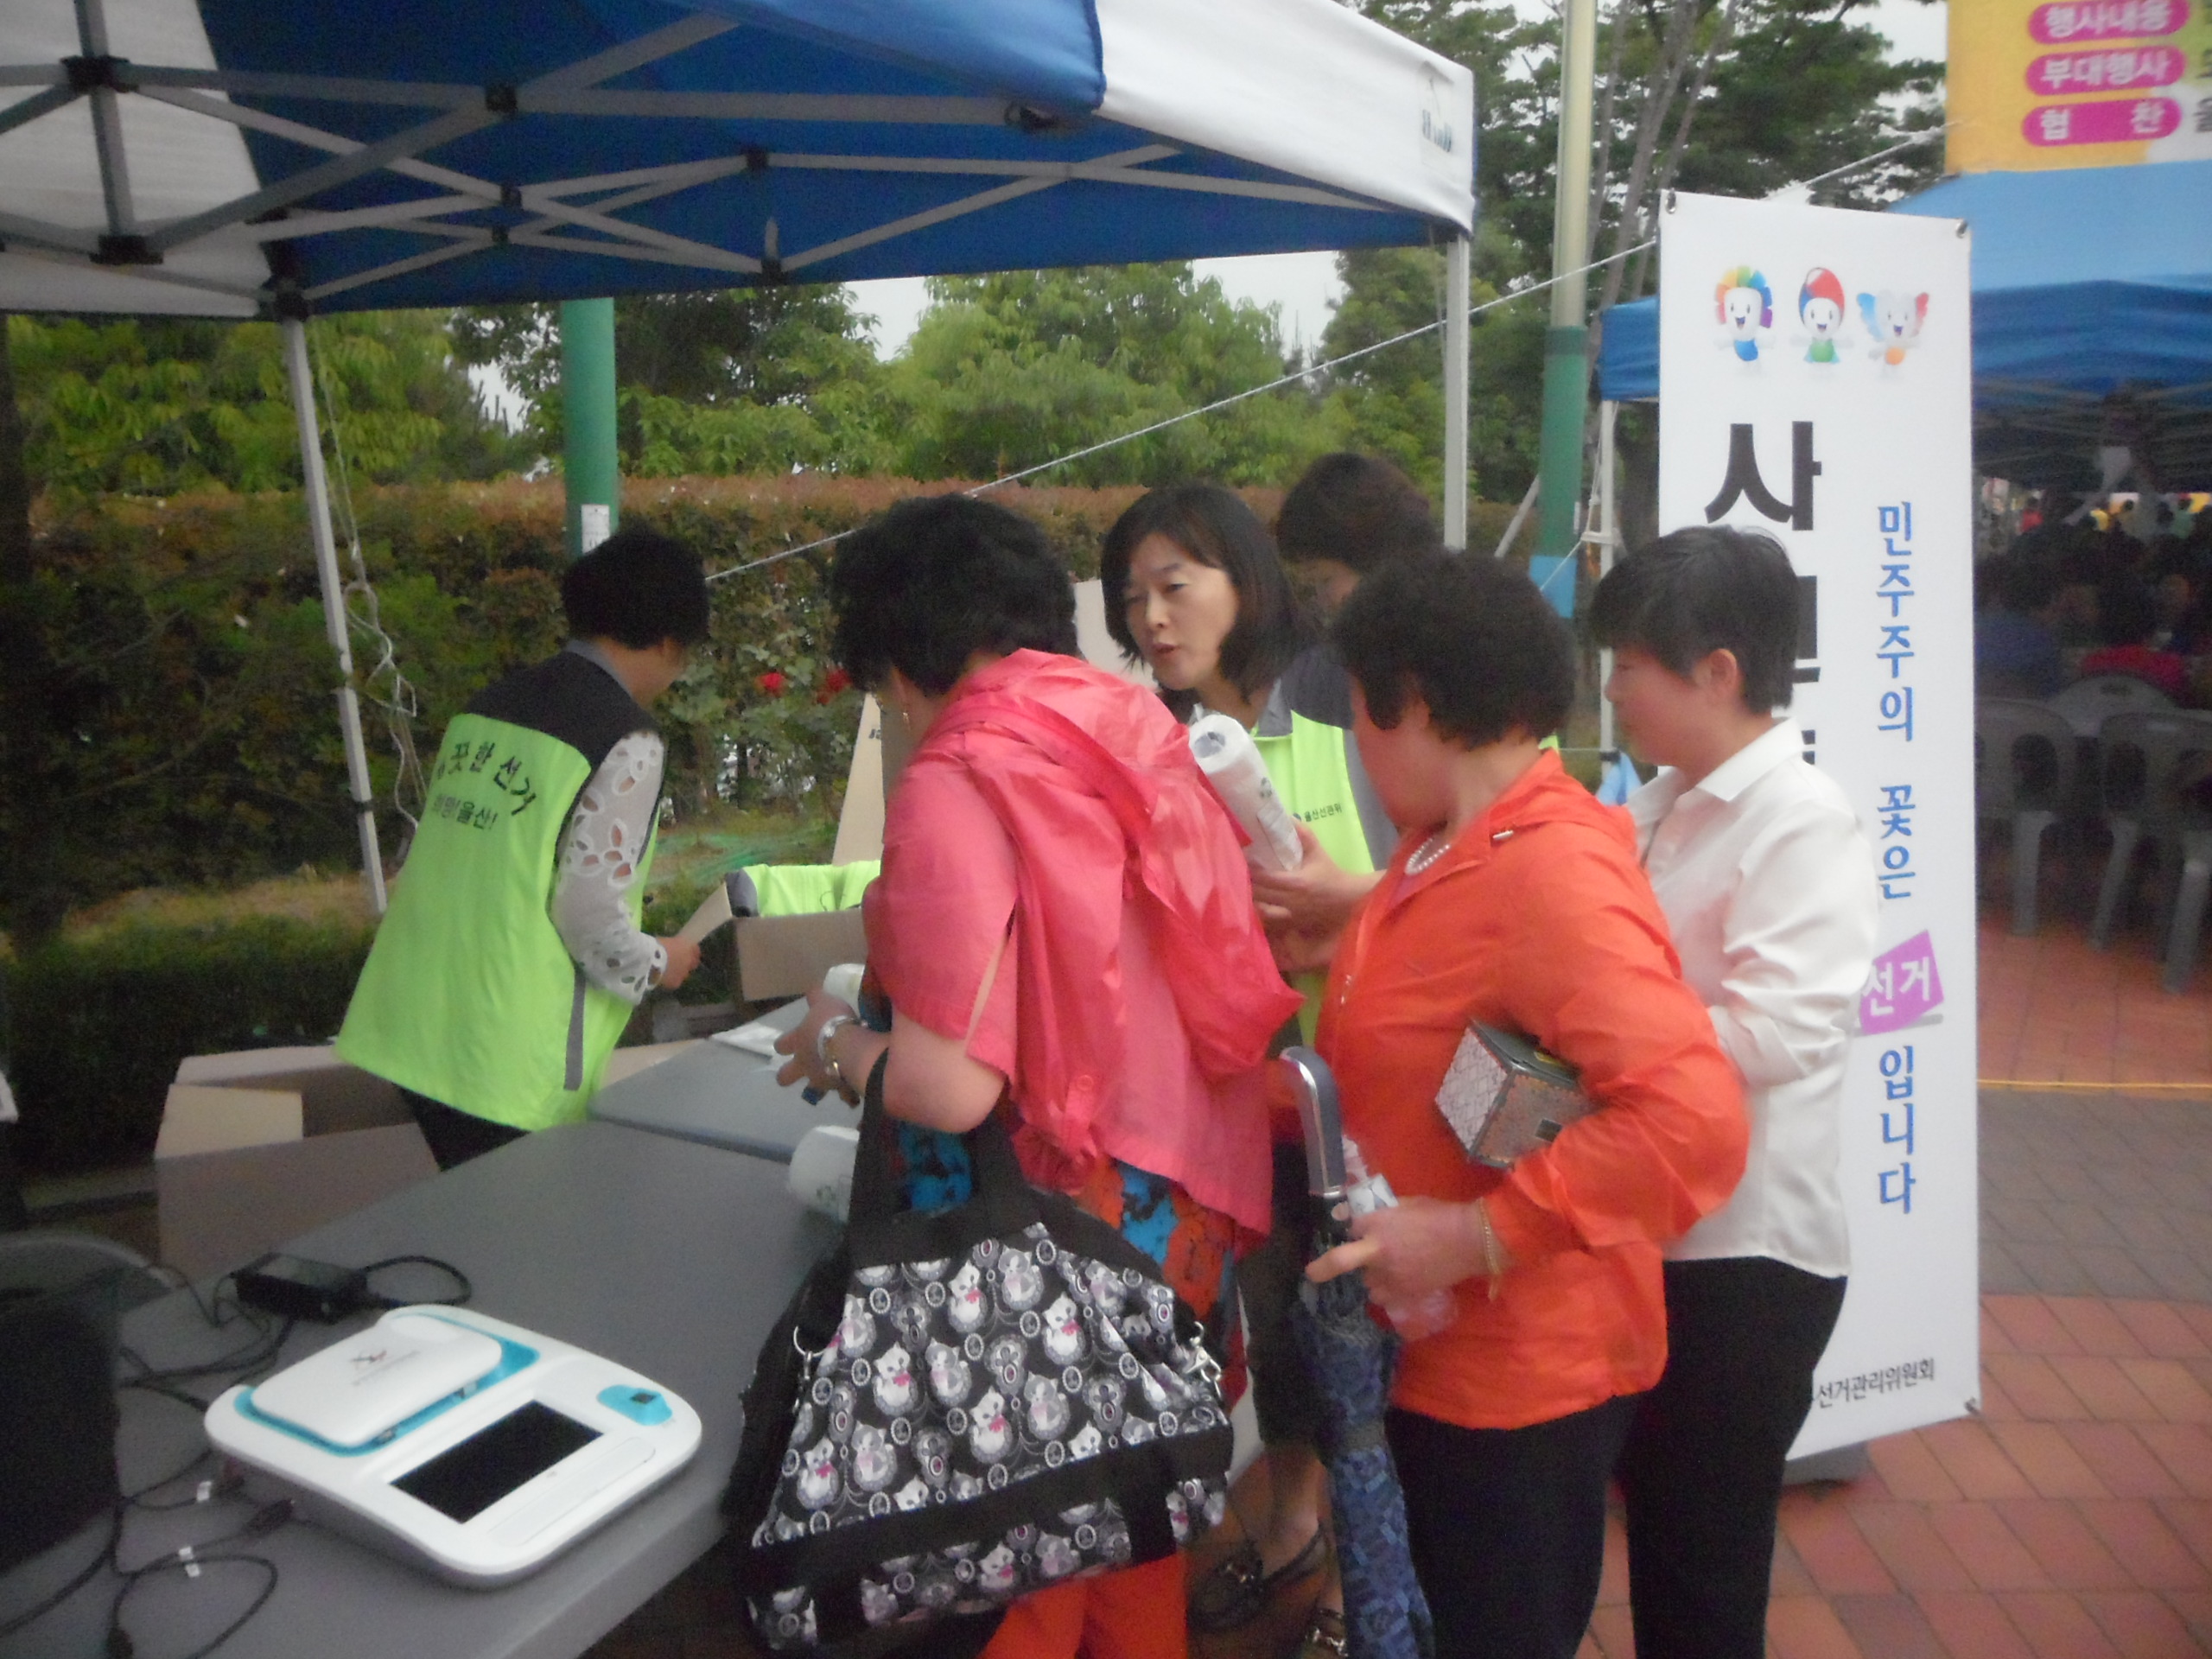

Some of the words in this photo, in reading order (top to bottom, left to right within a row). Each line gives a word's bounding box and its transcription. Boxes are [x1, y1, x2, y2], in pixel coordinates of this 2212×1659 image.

[2044, 0, 2171, 38] 행사내용
[2041, 52, 2171, 89] 부대행사
[1876, 500, 1916, 742] 민주주의
[1877, 785, 1916, 899] 꽃은
[1862, 956, 1931, 1016] 선거
[1878, 1046, 1916, 1214] 입니다
[1816, 1357, 1936, 1408] 선거관리위원회
